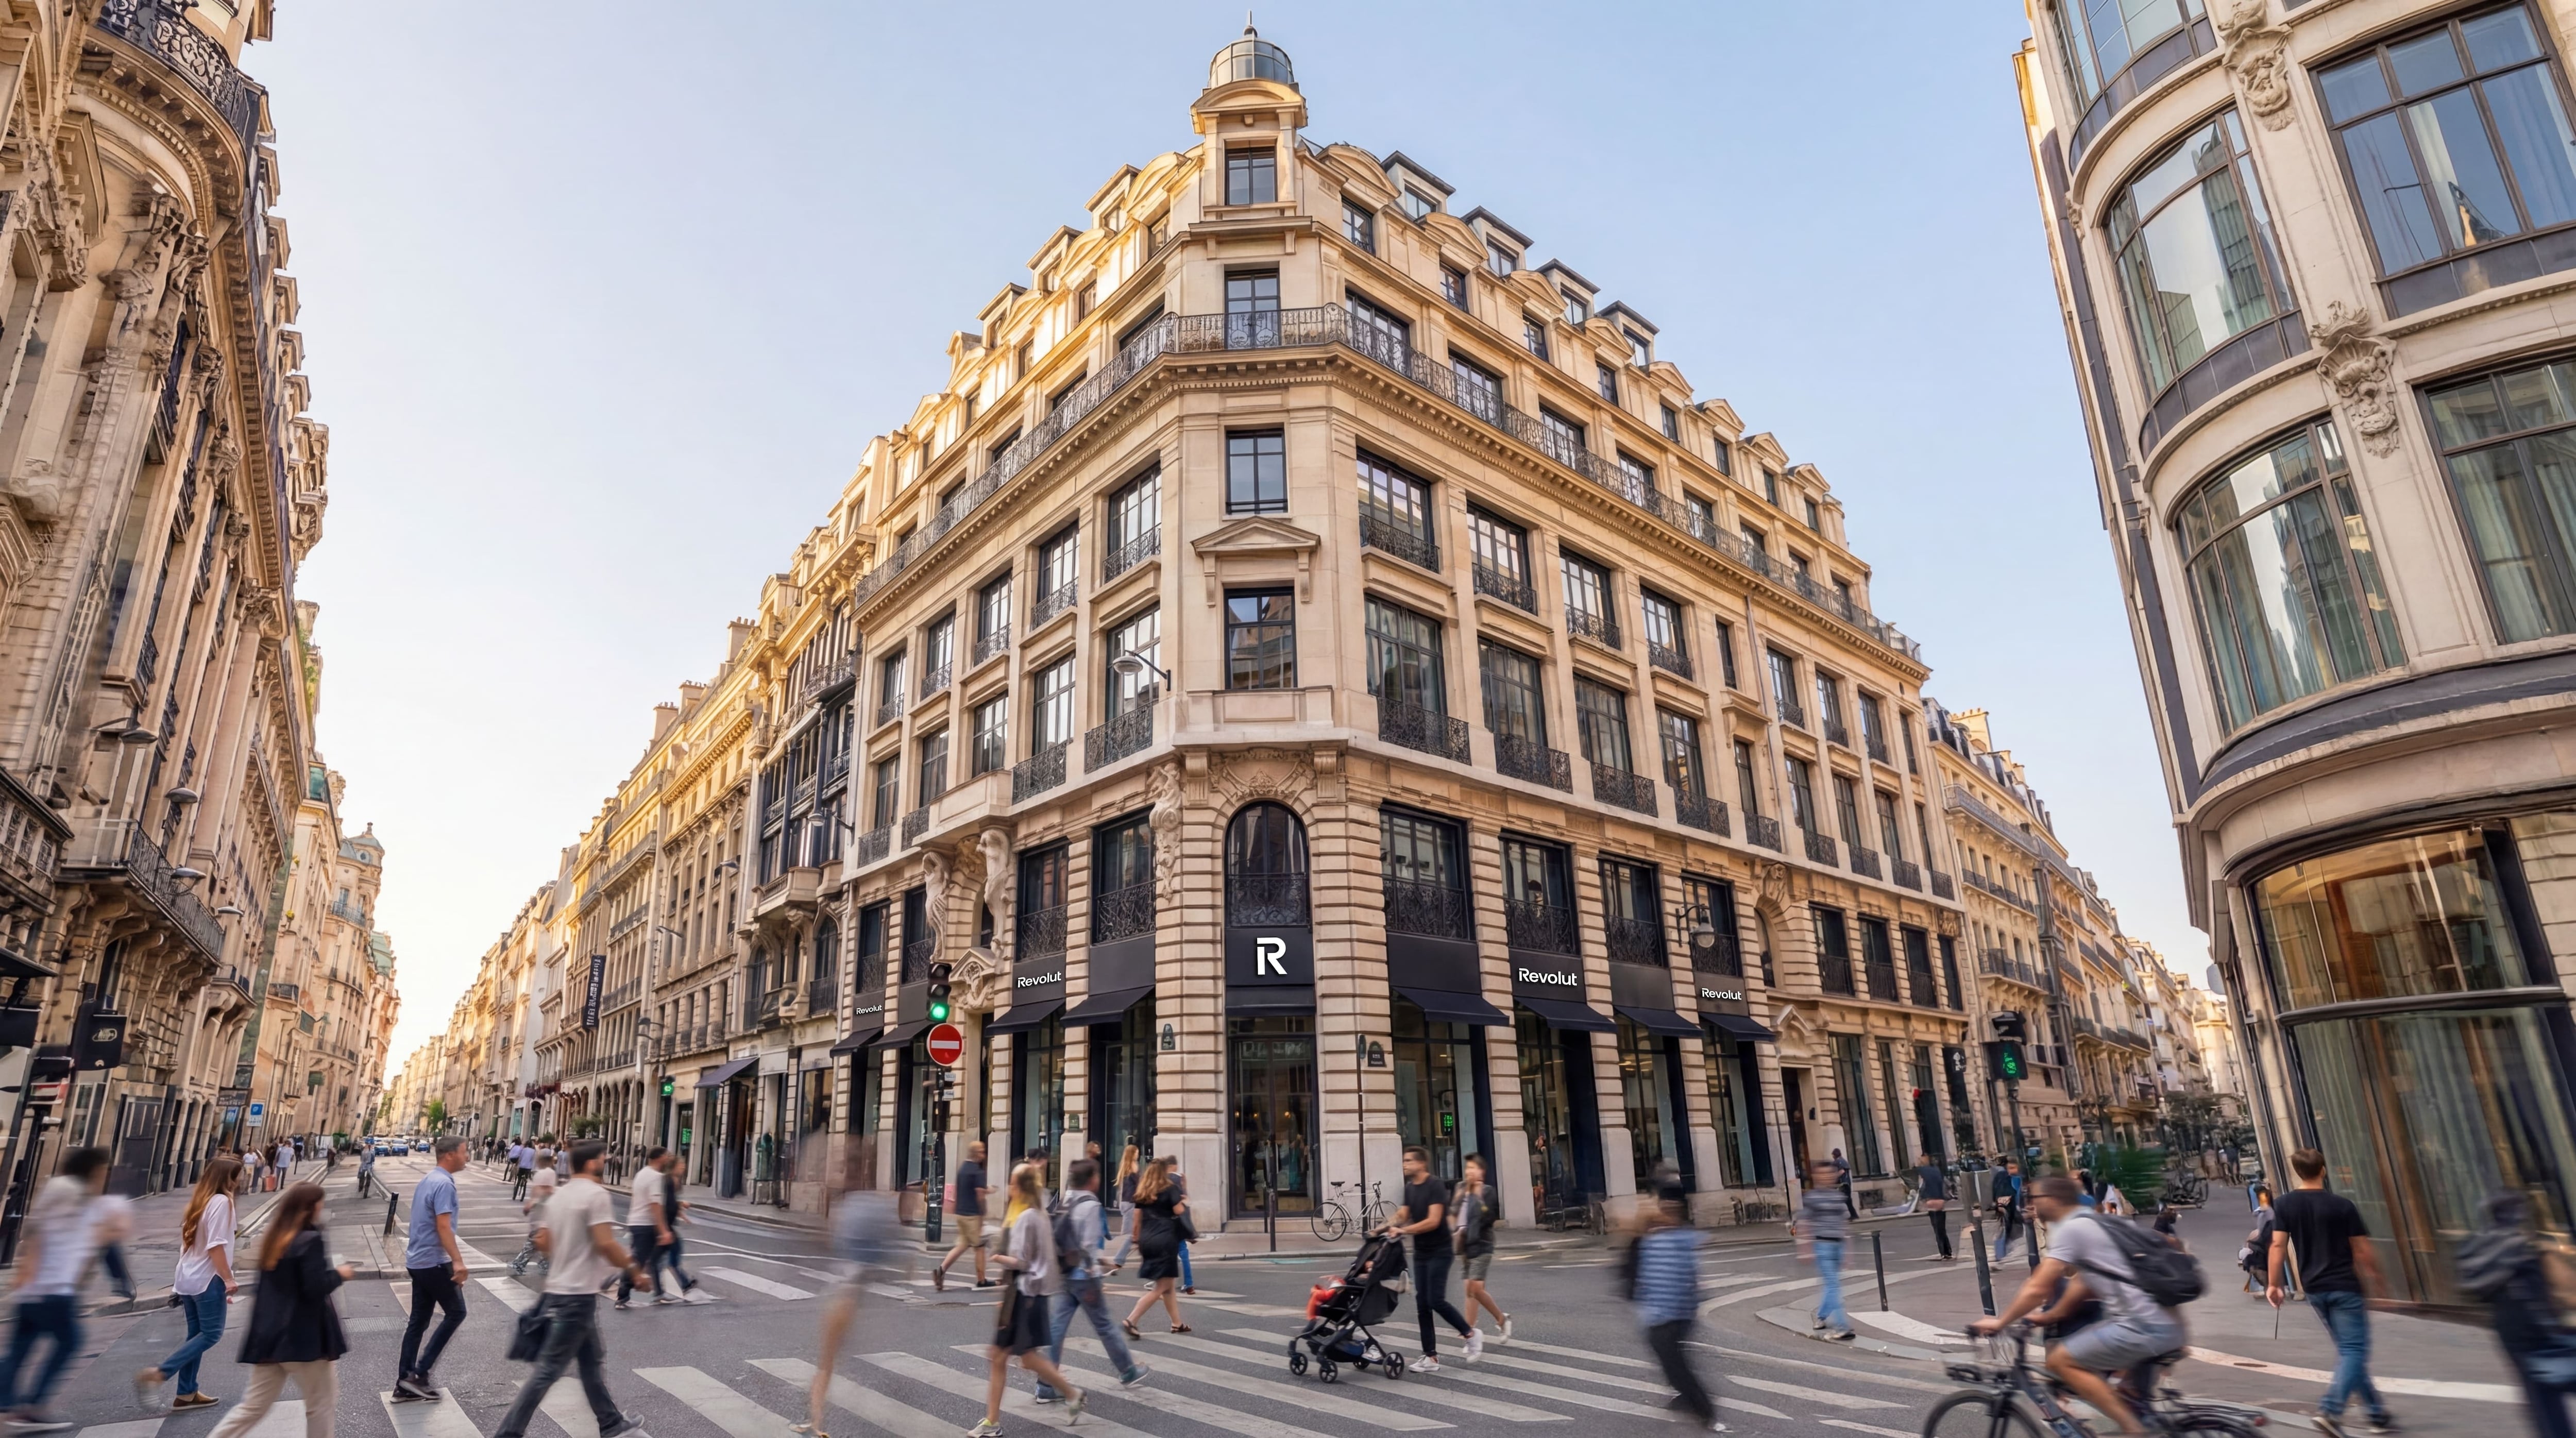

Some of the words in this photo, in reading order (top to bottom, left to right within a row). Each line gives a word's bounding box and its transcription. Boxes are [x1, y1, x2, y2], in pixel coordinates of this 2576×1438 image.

[1257, 937, 1287, 975] R
[1018, 971, 1061, 988] Revolut
[1519, 968, 1577, 986] Revolut
[1702, 988, 1742, 1000] Revolut
[856, 1005, 882, 1014] Revolut
